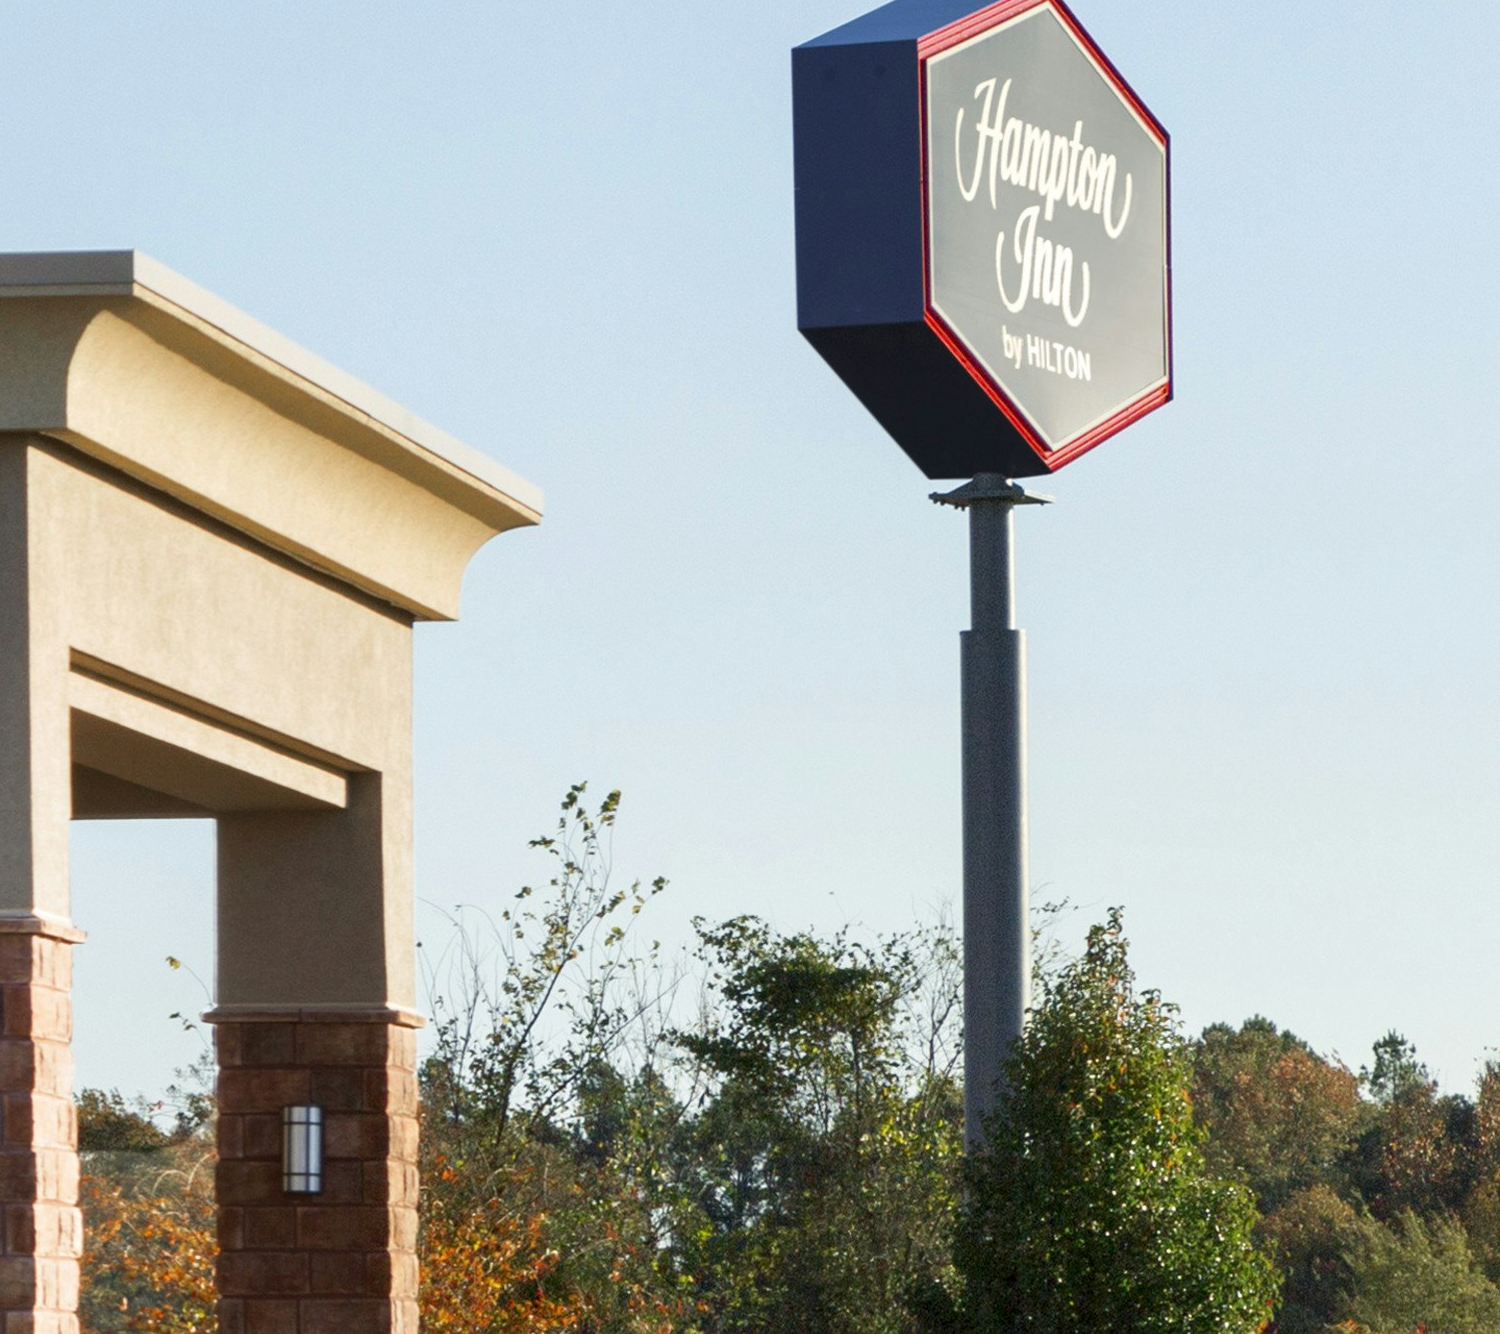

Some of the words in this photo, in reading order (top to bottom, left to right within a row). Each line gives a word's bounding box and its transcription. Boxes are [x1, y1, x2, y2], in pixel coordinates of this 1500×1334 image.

[955, 78, 1132, 238] Hampton
[996, 205, 1089, 327] Inn
[1002, 325, 1023, 369] by
[1027, 334, 1091, 381] HILTON
